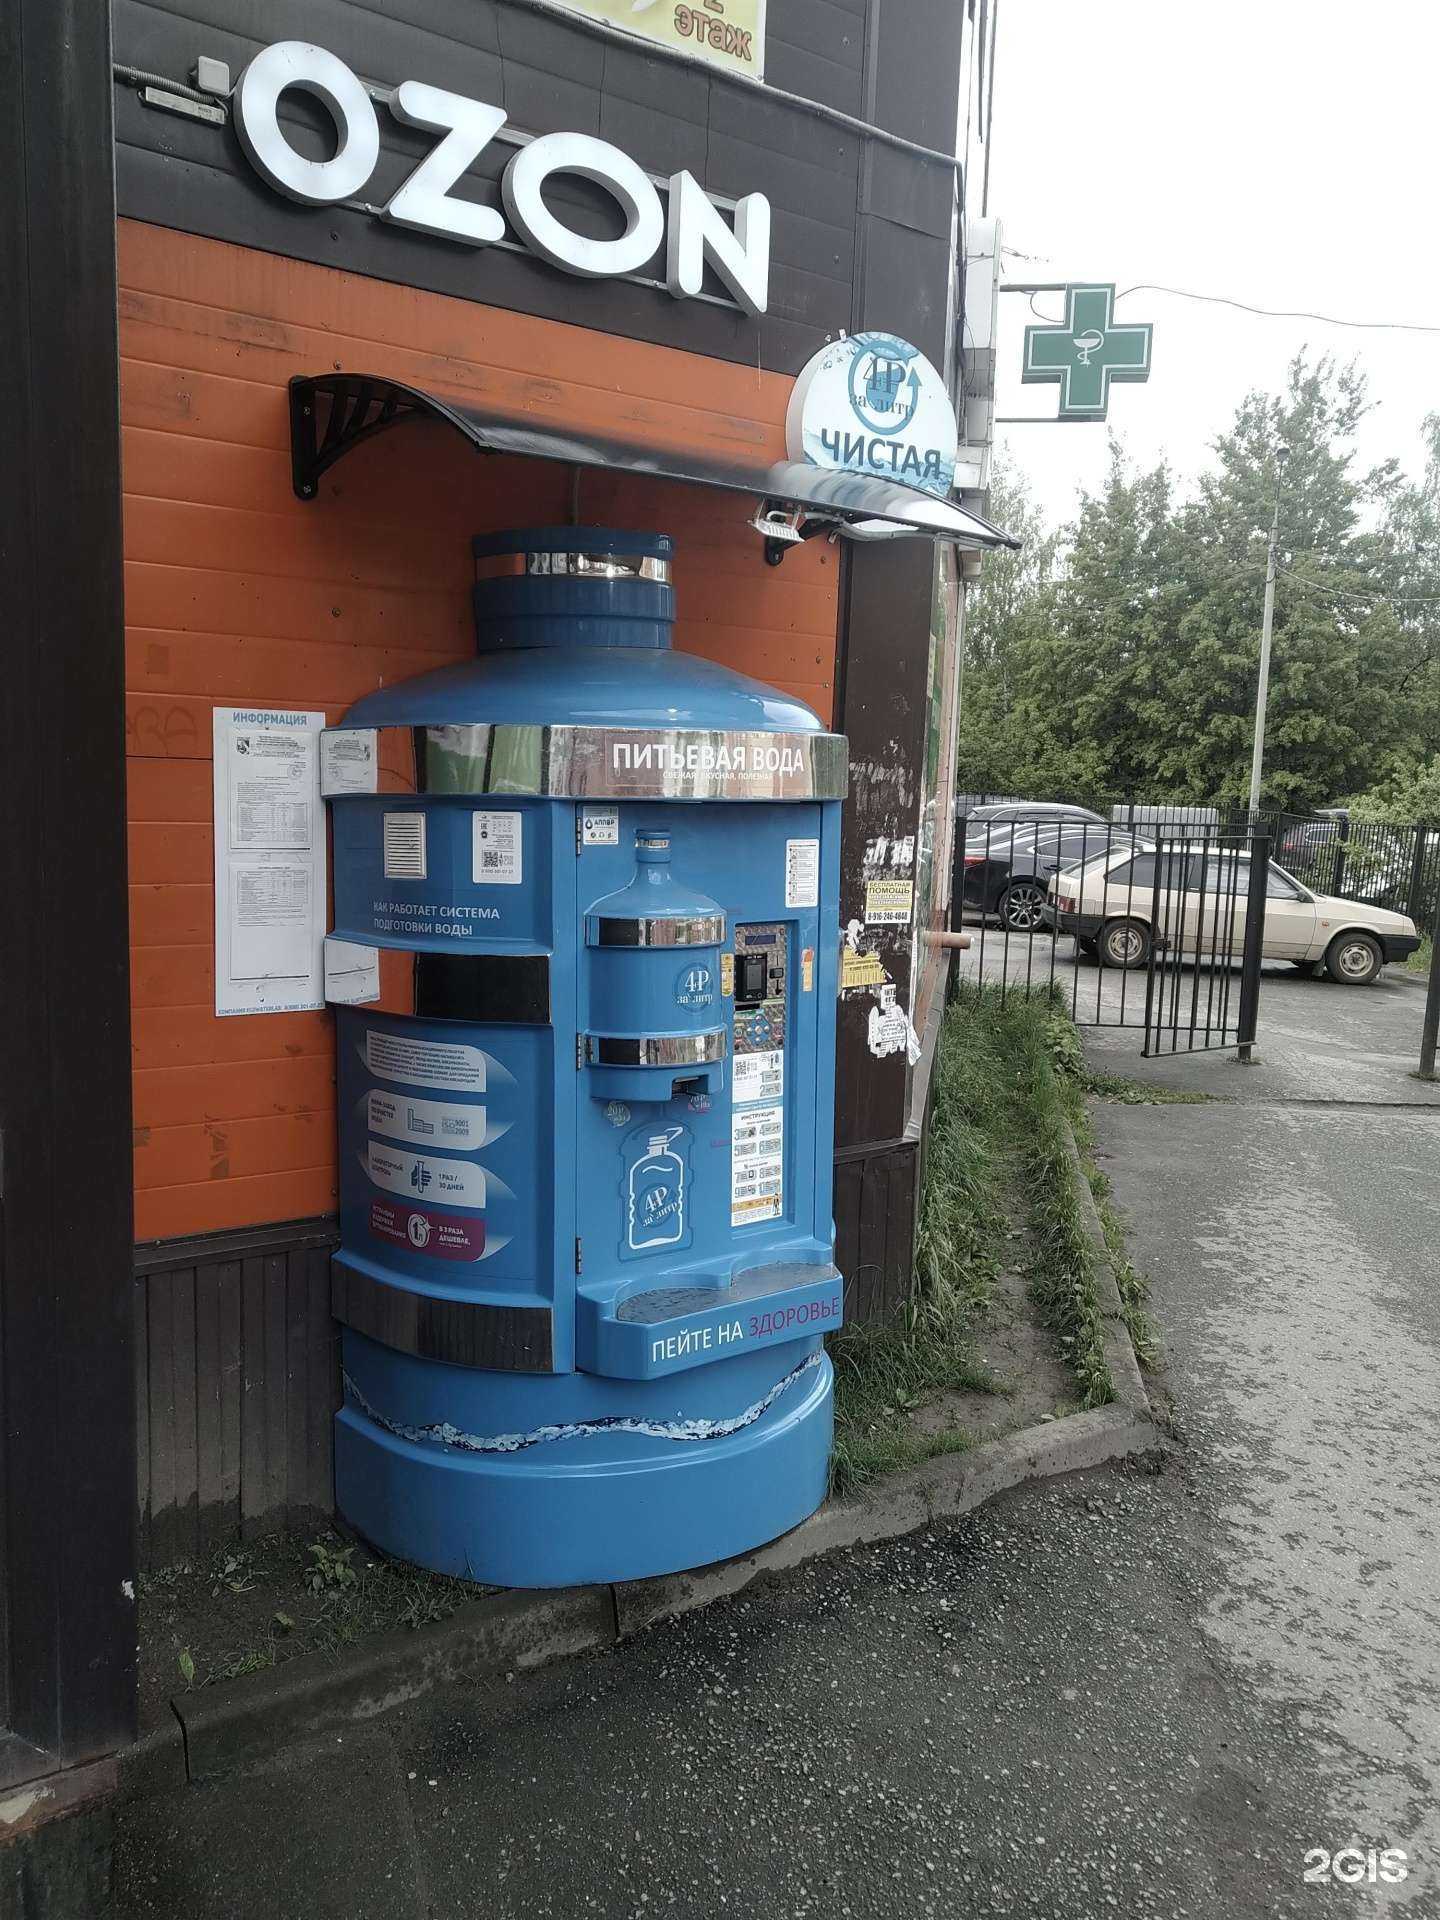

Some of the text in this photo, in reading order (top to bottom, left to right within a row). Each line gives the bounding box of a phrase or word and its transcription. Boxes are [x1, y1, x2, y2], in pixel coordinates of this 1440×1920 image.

[674, 4, 752, 61] этаж
[233, 40, 771, 316] OZON
[821, 428, 942, 479] ЧИСТАЯ
[233, 711, 307, 725] ИНФОРМАЦИЯ
[613, 743, 805, 778] ПИТЬЕВАЯ ВОДА
[869, 887, 911, 895] ПОМОЩЬ
[373, 901, 500, 920] КАК РАБОТАЕТ СИСТЕМА
[374, 918, 473, 937] ПОДГОТОВКИ ВОДЫ
[652, 1296, 840, 1362] ПЕЙТЕ НА ЗДОРОВЬЕ
